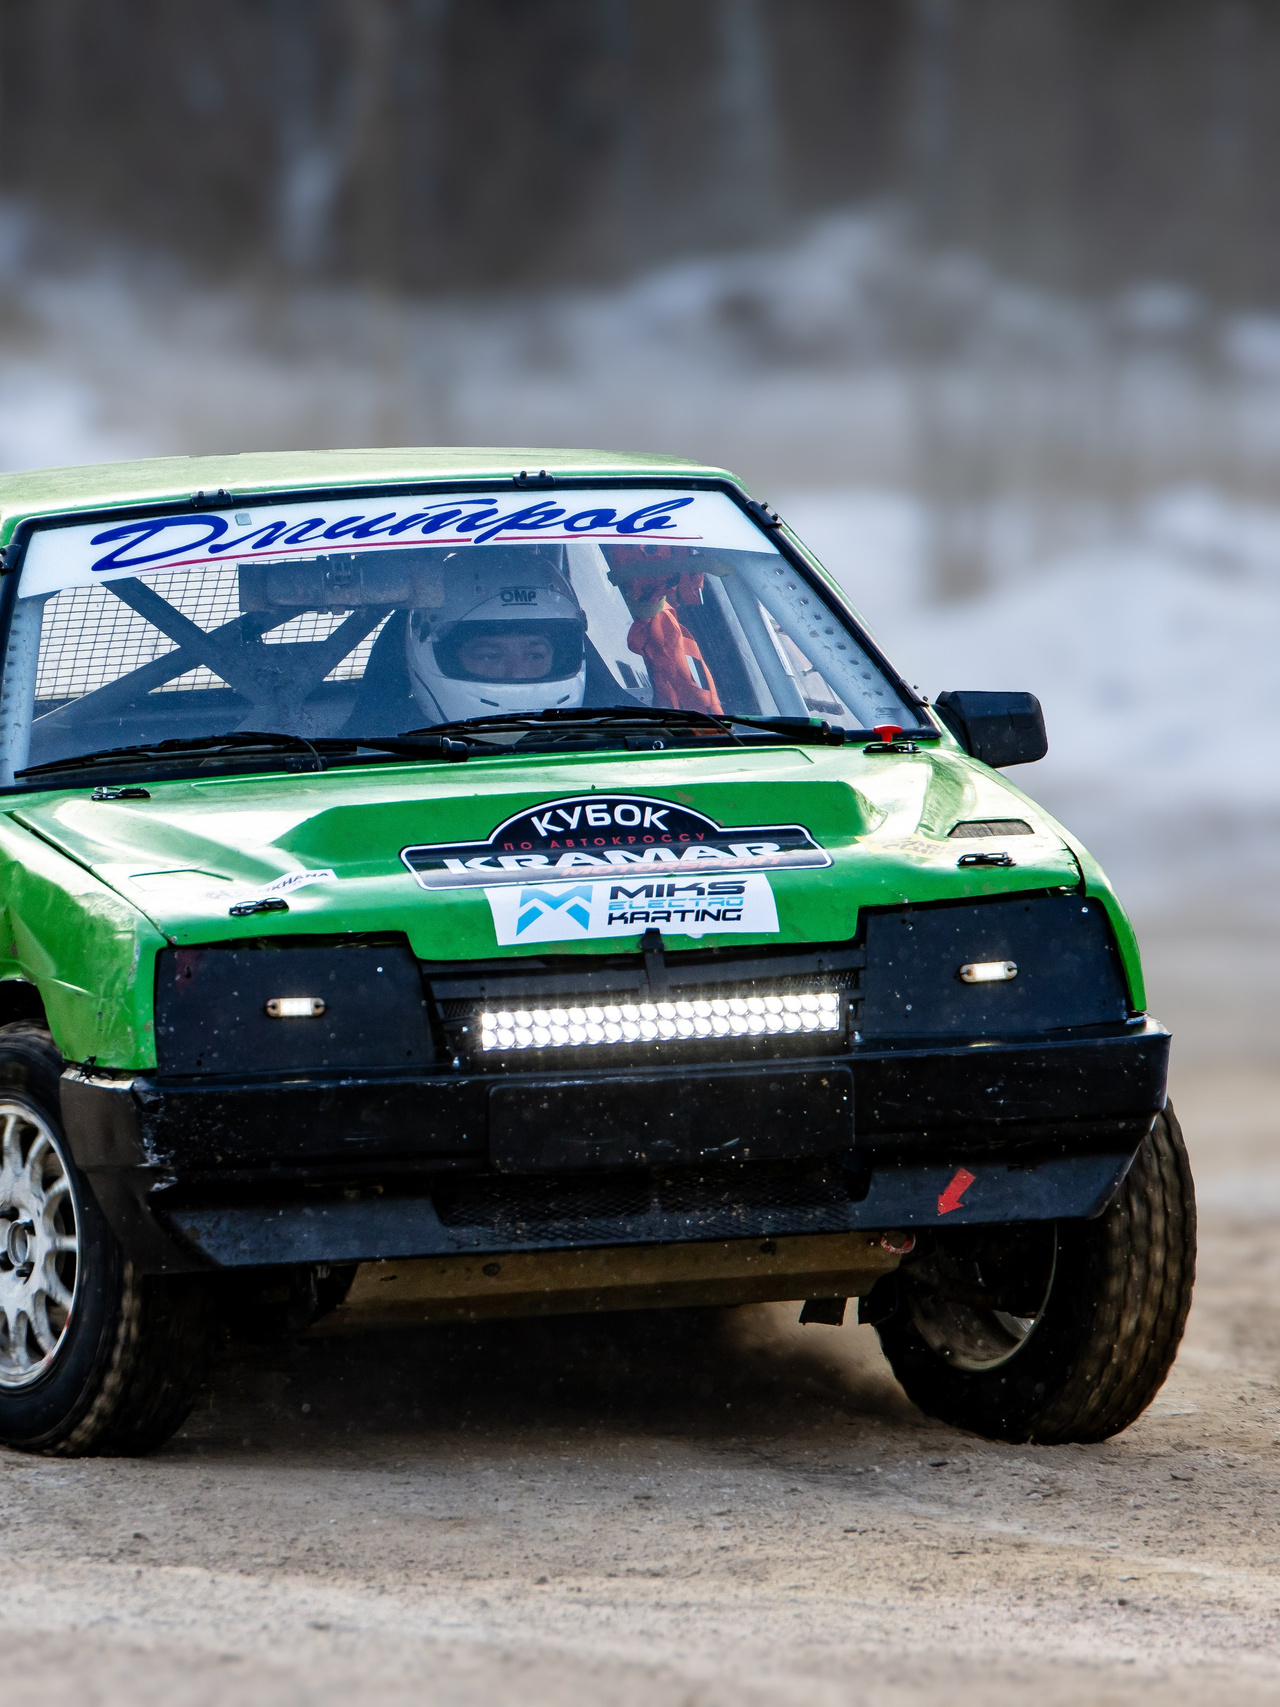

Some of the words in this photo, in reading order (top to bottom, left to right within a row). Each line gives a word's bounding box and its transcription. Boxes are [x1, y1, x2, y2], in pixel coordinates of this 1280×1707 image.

[90, 498, 695, 571] Дмитров
[500, 589, 537, 603] OMP
[531, 803, 670, 838] КУБОК
[503, 841, 533, 851] ПО
[550, 832, 705, 849] АВТОКРОССУ
[442, 842, 786, 875] KRAMAR
[561, 854, 788, 877] MOTORSPORT
[609, 880, 748, 900] MIKS
[608, 896, 744, 911] ELECTRO
[607, 908, 744, 926] KARTING
